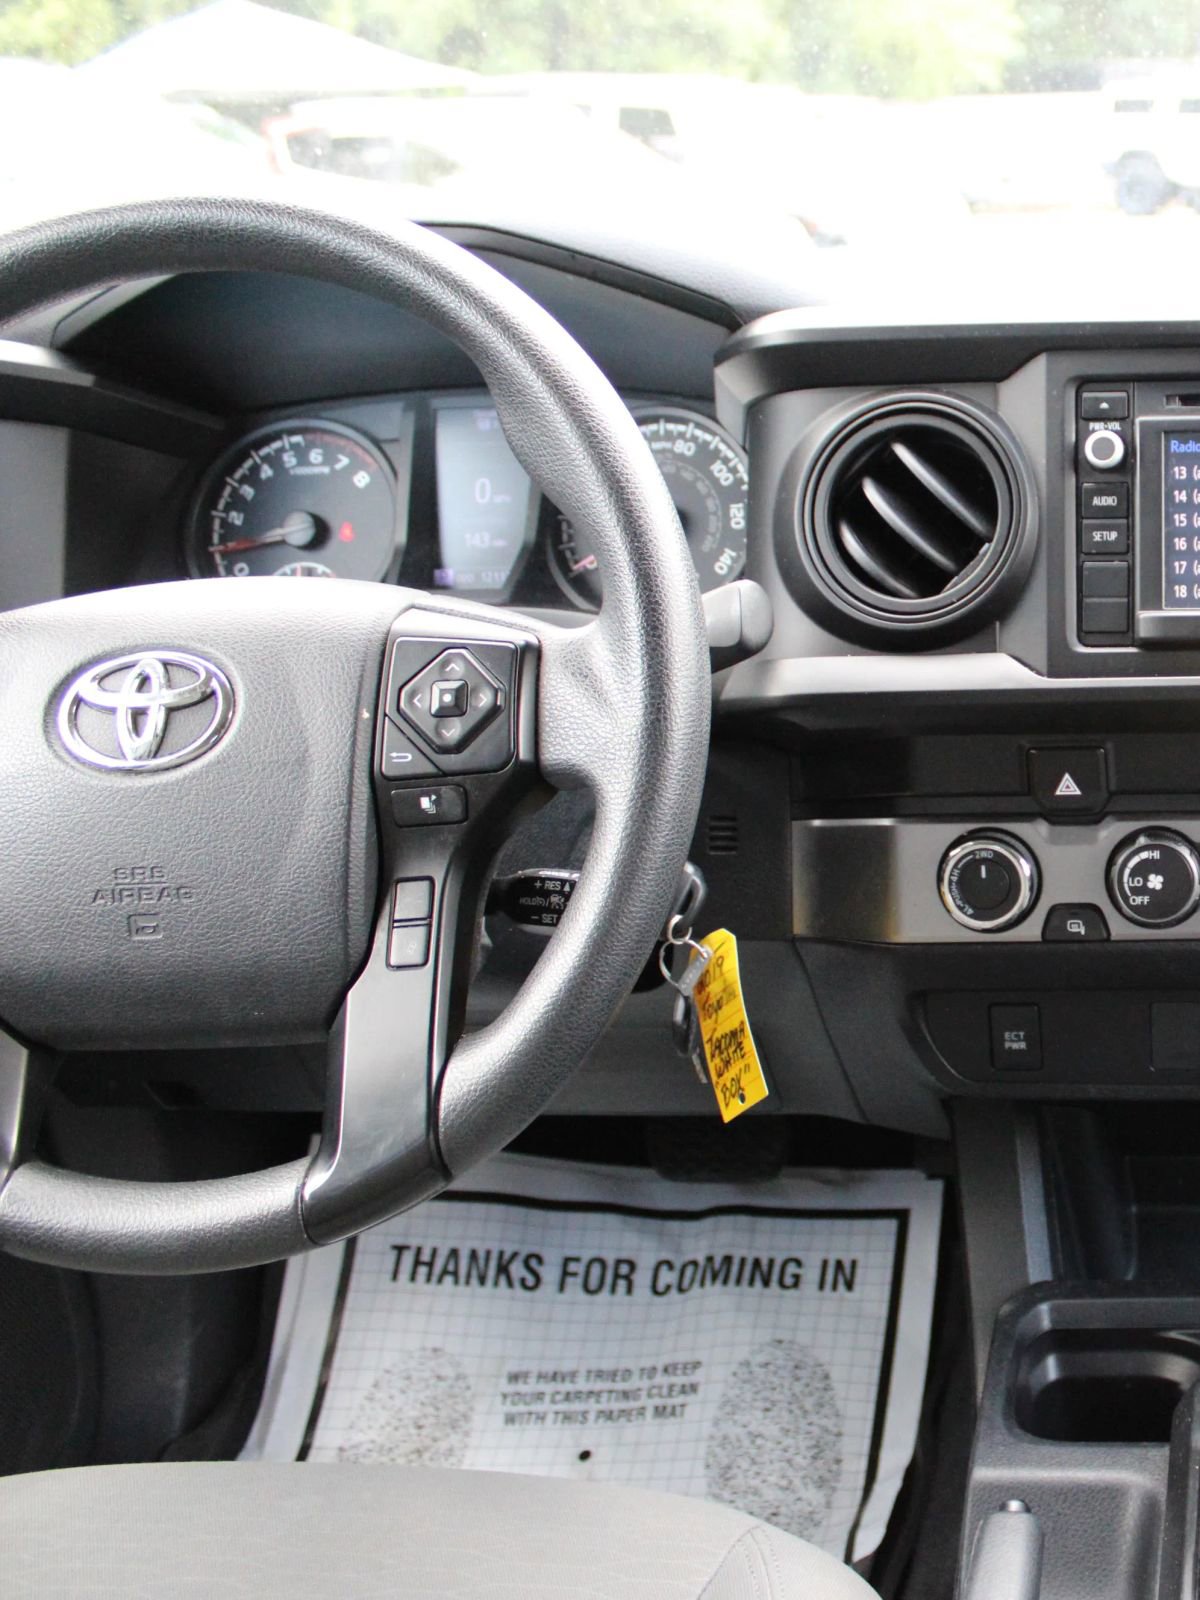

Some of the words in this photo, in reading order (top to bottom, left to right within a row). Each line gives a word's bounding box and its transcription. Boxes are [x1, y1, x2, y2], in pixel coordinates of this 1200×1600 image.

[673, 439, 696, 456] 80
[282, 451, 297, 468] 5
[309, 448, 324, 464] 6
[334, 454, 350, 470] 7
[259, 464, 274, 480] 4
[353, 470, 370, 489] 8
[710, 459, 734, 486] 100
[1173, 466, 1187, 480] 13
[239, 484, 255, 500] 3
[474, 478, 492, 503] 0
[1173, 490, 1187, 503] 14
[1092, 495, 1118, 506] AUDIO
[228, 511, 244, 526] 2
[729, 503, 745, 530] 120
[1173, 514, 1187, 527] 15
[1092, 532, 1118, 541] SETUP
[1173, 537, 1187, 551] 16
[714, 547, 737, 575] 140
[1173, 561, 1187, 575] 17
[1173, 585, 1187, 598] 18
[1149, 850, 1160, 859] HI
[544, 880, 561, 890] RES
[1129, 877, 1143, 887] LO
[92, 885, 196, 904] AIRBAG
[1129, 896, 1150, 905] OFF
[541, 914, 558, 924] SET
[1004, 1031, 1025, 1040] ECT
[1004, 1041, 1027, 1050] PWR
[390, 1243, 545, 1292] THANKS
[558, 1255, 637, 1297] FOR
[651, 1253, 804, 1297] COMING
[817, 1258, 858, 1293] IN
[507, 1370, 533, 1385] WE
[536, 1369, 579, 1384] HAVE
[585, 1368, 634, 1384] TRIED
[639, 1366, 657, 1380] TO
[662, 1361, 703, 1377] KEEP
[500, 1391, 545, 1406] YOUR
[550, 1388, 643, 1405] CARPETING
[647, 1382, 699, 1399] CLEAN
[504, 1411, 547, 1426] WITH
[552, 1410, 589, 1425] THIS
[594, 1406, 646, 1424] PAPER
[652, 1404, 688, 1420] MAT
